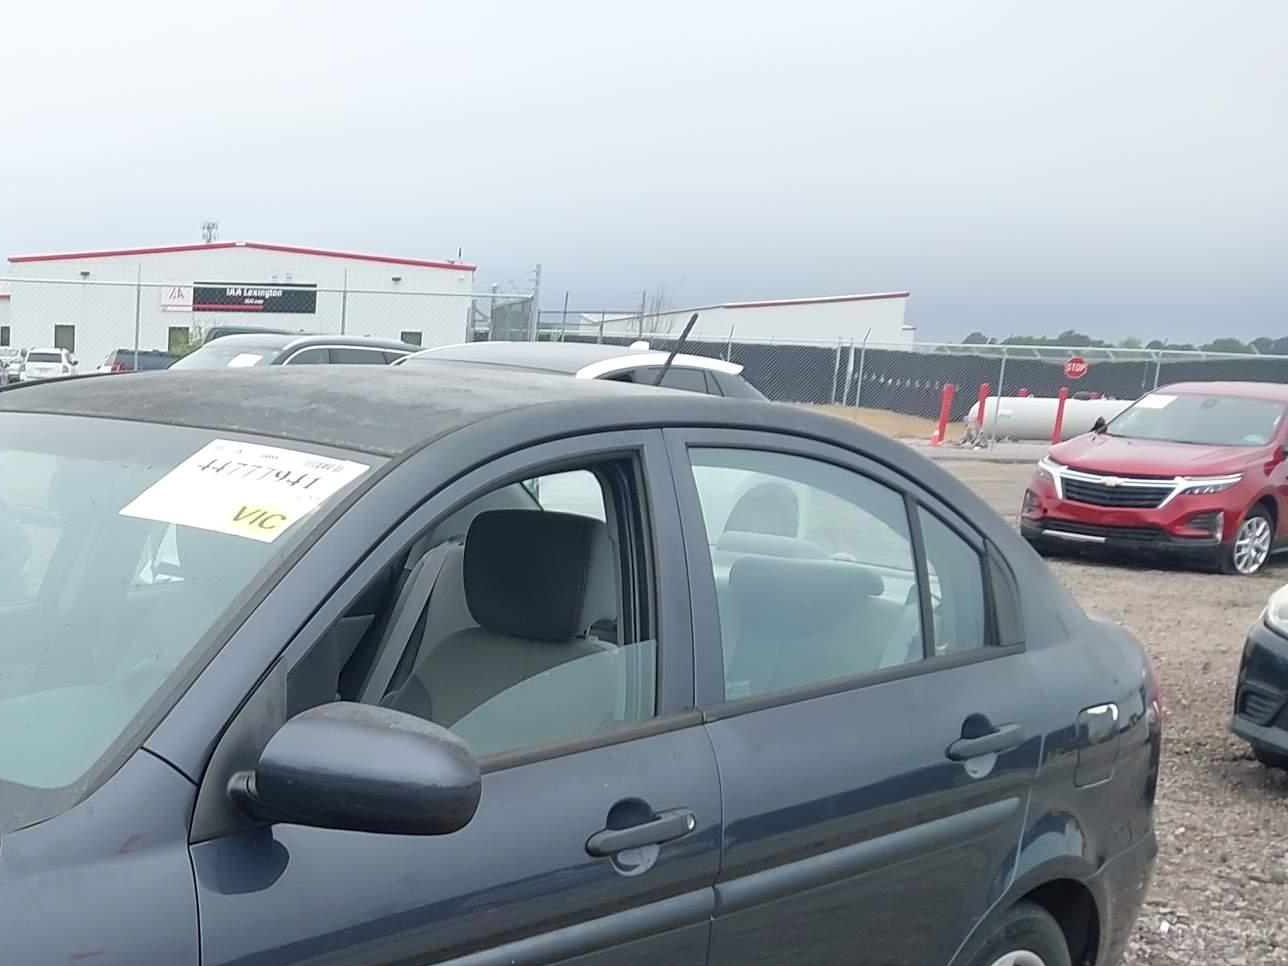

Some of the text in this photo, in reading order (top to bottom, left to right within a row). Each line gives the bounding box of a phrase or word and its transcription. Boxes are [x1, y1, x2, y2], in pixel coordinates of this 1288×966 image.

[226, 287, 282, 298] IAA Lexington
[1066, 363, 1085, 372] STOP
[197, 458, 321, 489] 44777941
[232, 505, 286, 529] VIC
